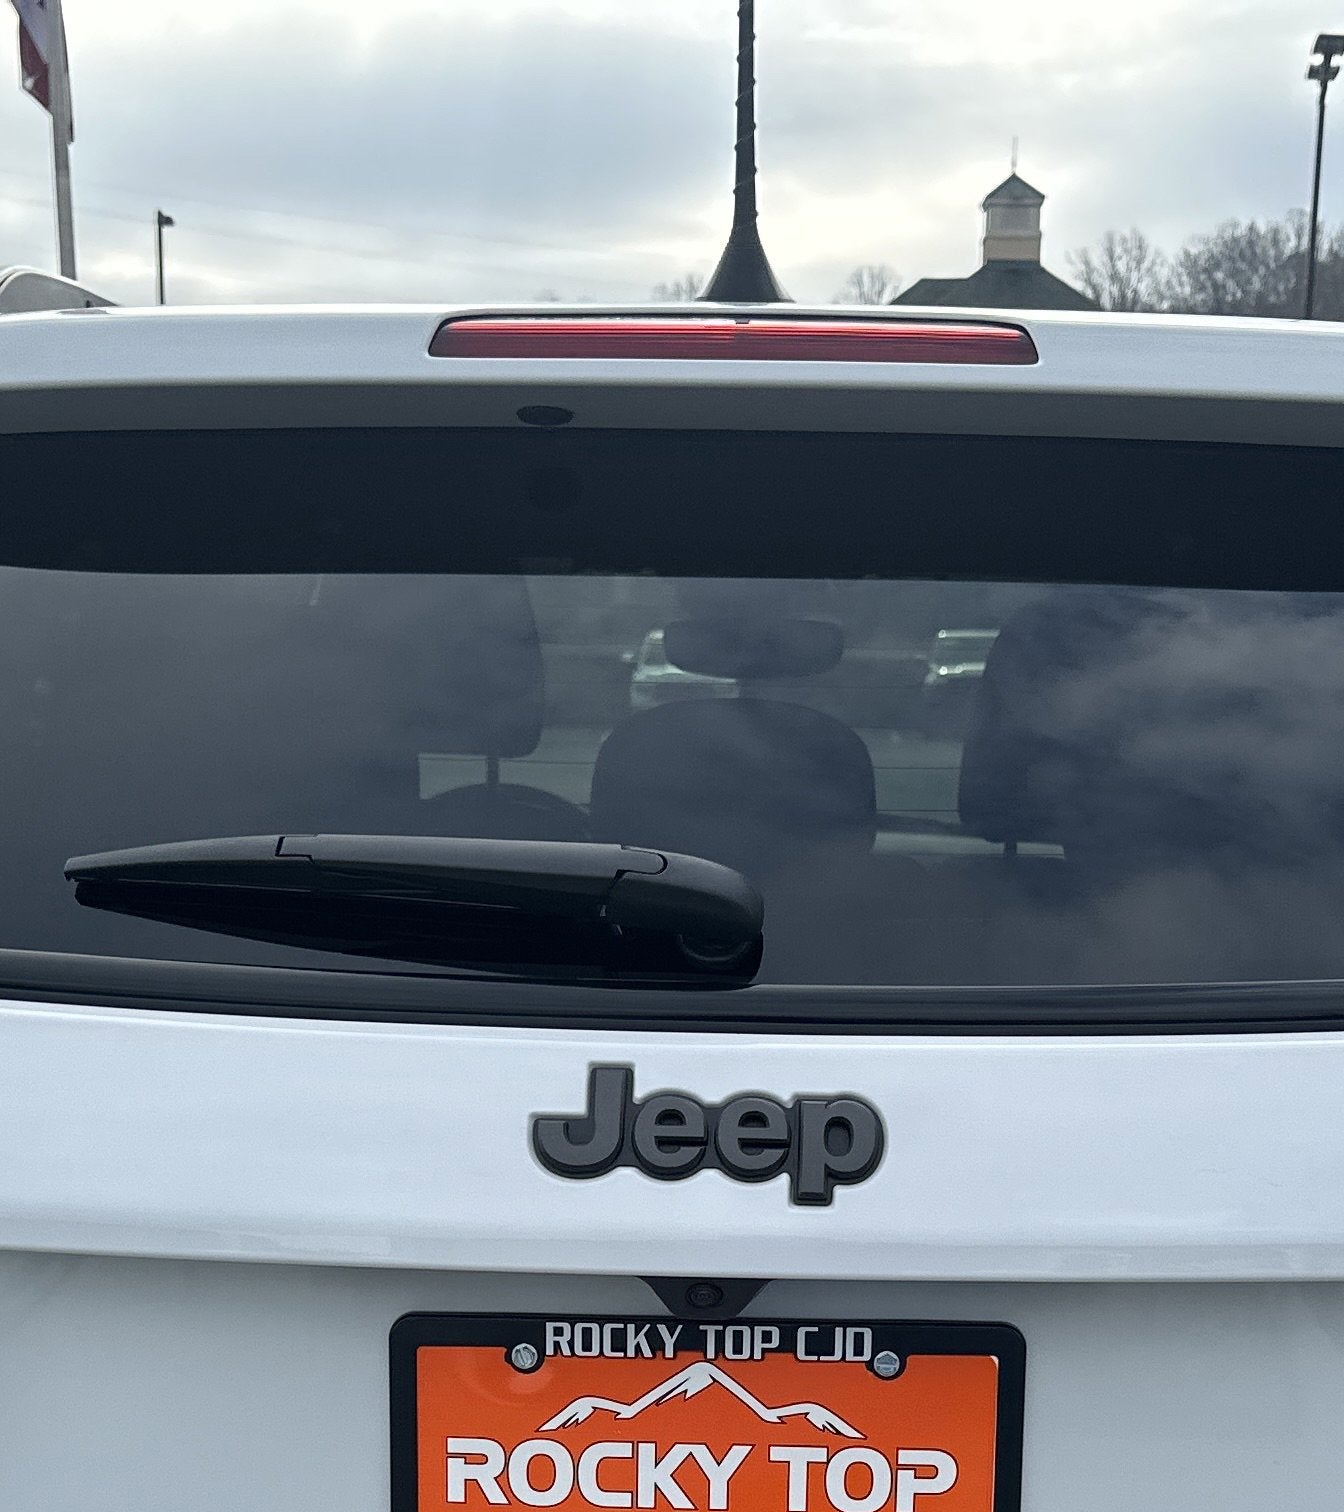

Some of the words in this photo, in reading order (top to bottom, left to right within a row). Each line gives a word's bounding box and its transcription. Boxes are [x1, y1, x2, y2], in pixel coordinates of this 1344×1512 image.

[532, 1063, 886, 1207] Jeep
[545, 1321, 682, 1359] ROCKY
[699, 1324, 780, 1361] TOP
[796, 1326, 873, 1362] CJD
[446, 1437, 756, 1510] ROCKY
